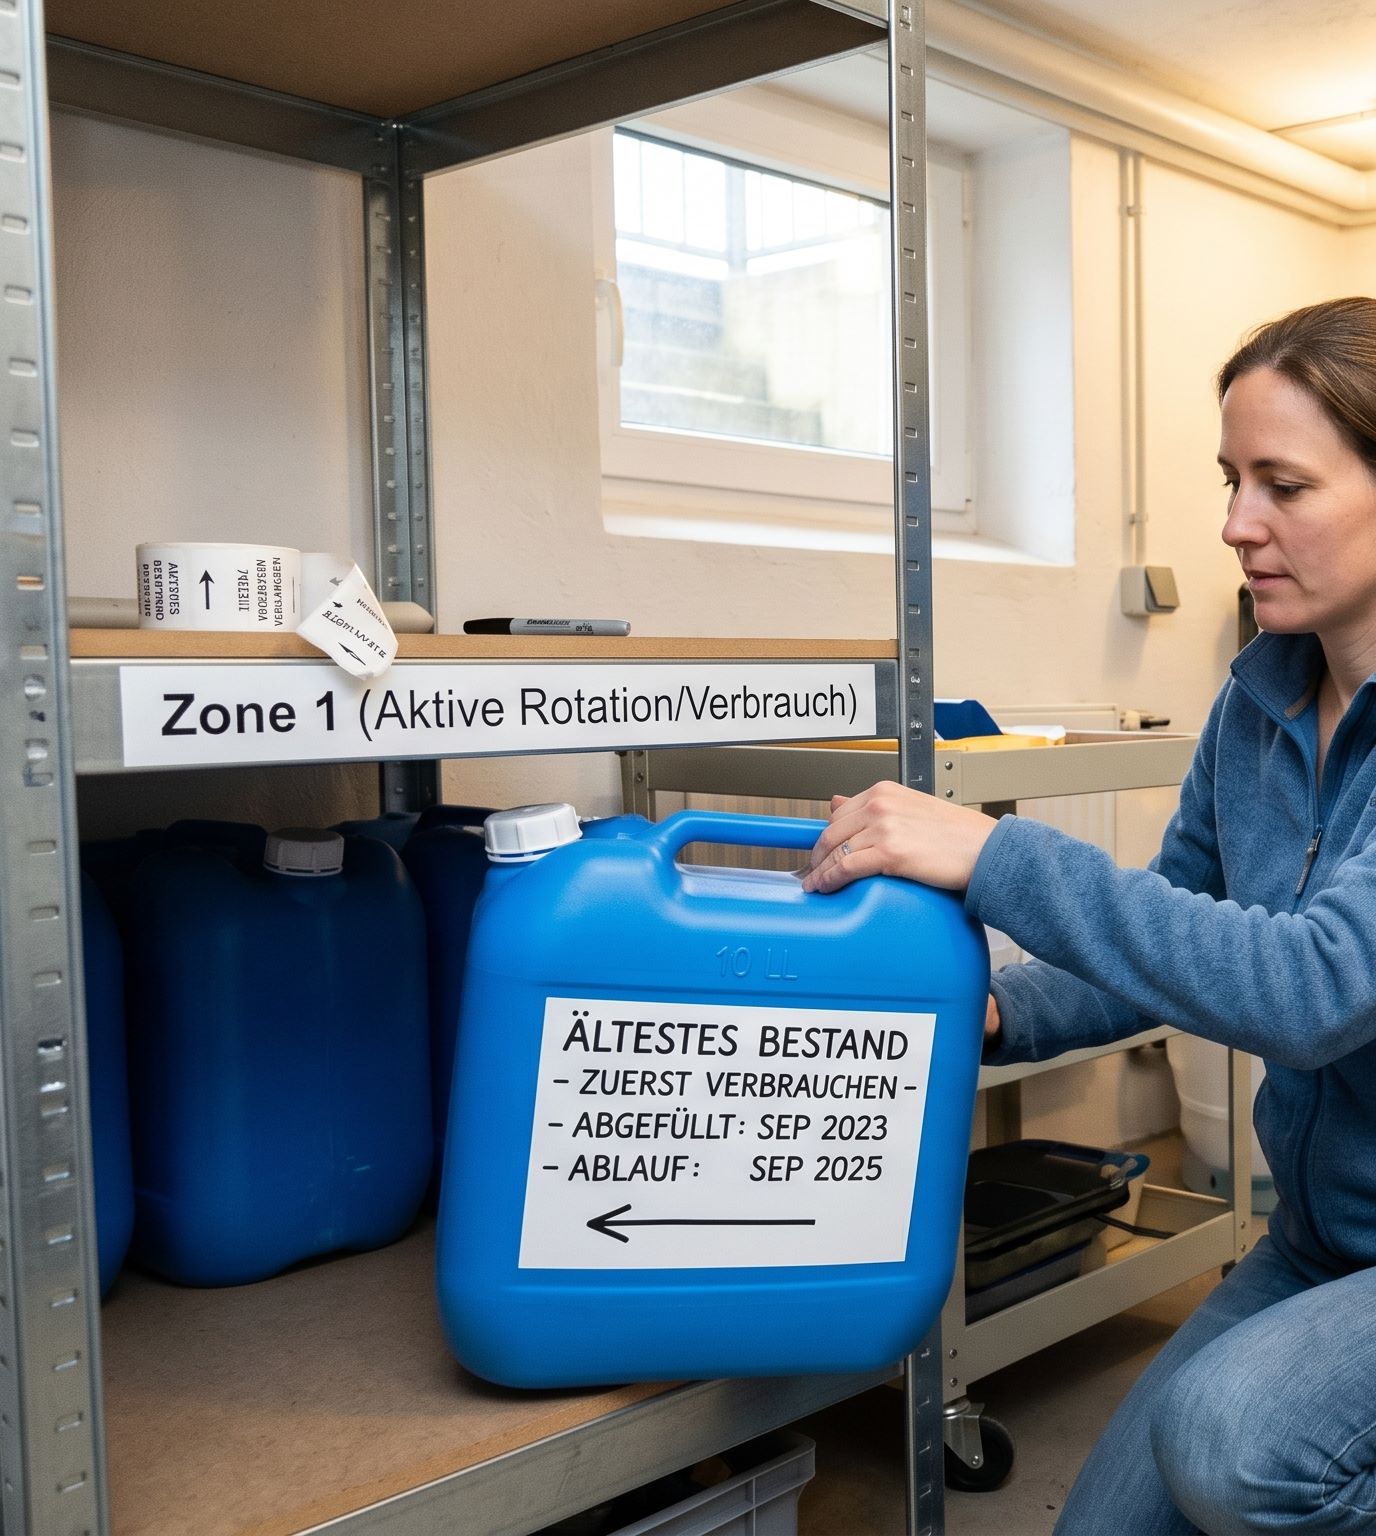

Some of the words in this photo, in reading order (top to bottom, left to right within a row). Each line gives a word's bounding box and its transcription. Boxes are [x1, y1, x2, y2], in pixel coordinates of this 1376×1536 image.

[161, 693, 296, 737] Zone
[316, 690, 336, 732] 1
[359, 689, 505, 742] (Aktive
[520, 683, 857, 726] Rotation/Verbrauch)
[715, 945, 752, 978] 10
[562, 1009, 739, 1057] ÄLTESTES
[758, 1025, 909, 1061] BESTAND
[578, 1068, 693, 1097] ZUERST
[571, 1106, 746, 1140] ABGEFÜLLT:
[756, 1113, 811, 1140] SEP
[820, 1114, 888, 1141] 2023
[567, 1154, 700, 1182] ABLAUF:
[749, 1155, 804, 1182] SEP
[813, 1155, 883, 1182] 2025
